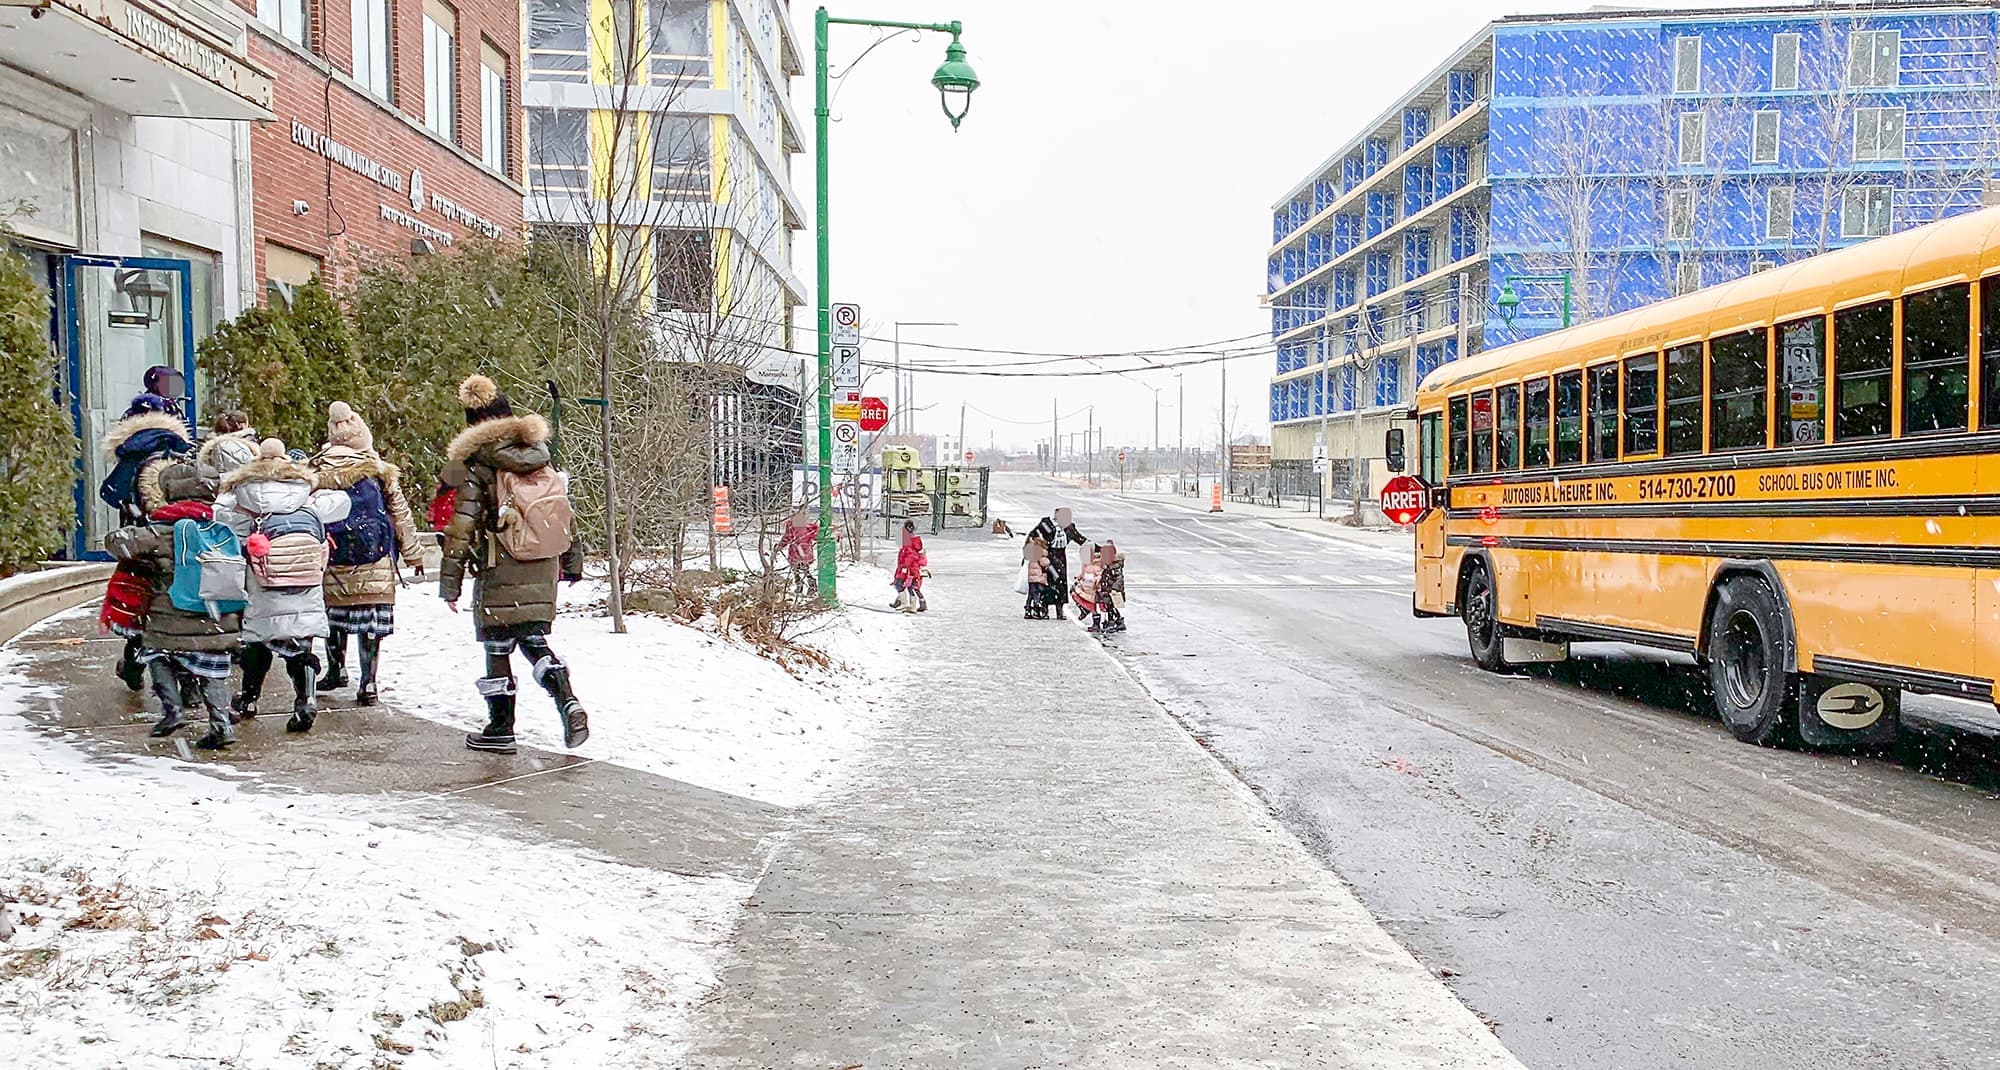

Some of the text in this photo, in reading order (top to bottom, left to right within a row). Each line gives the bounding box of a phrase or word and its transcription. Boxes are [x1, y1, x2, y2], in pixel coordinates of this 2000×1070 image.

[291, 115, 319, 153] ÉCOLE
[319, 134, 380, 183] COMMUNAUTAIRE
[841, 349, 851, 364] P
[861, 407, 887, 420] RRÊT
[1639, 474, 1735, 499] 514-730-2700
[1759, 468, 1899, 492] SCHOOL BUS ON TIME INC.
[1502, 486, 1542, 504] AUTOBUS
[1595, 482, 1617, 501] INC.
